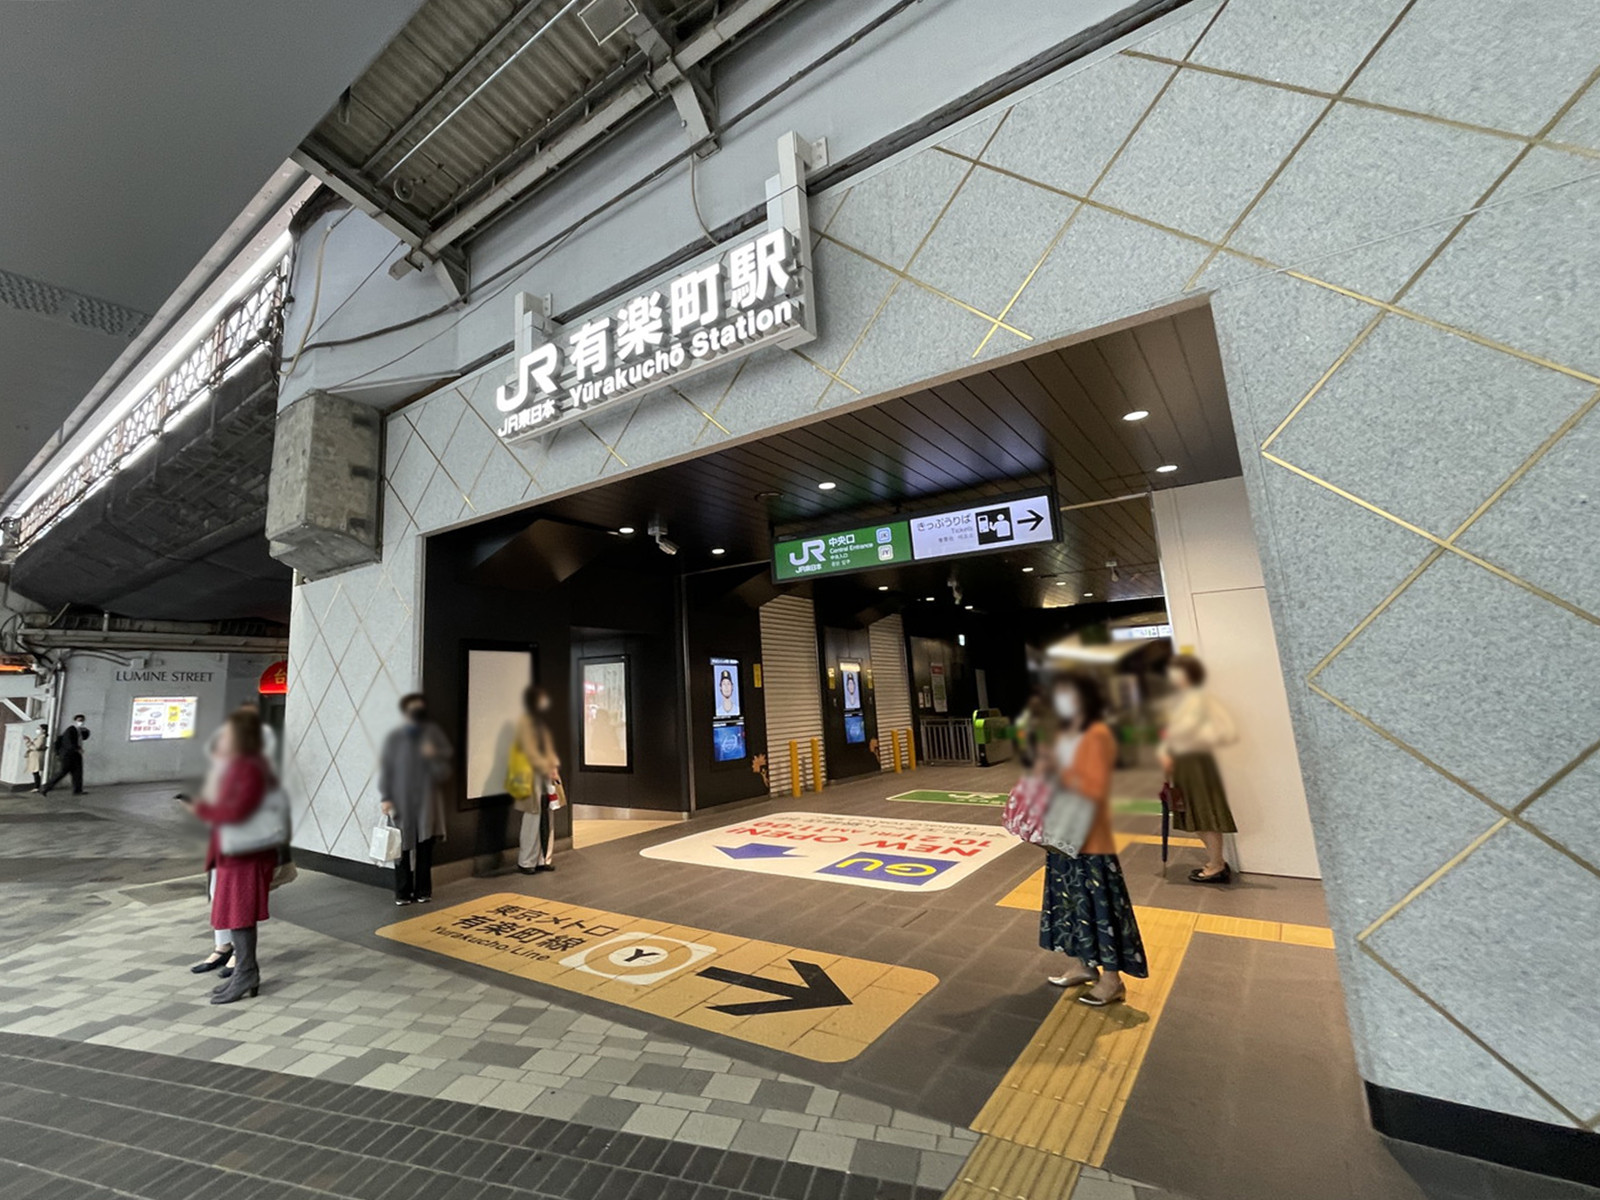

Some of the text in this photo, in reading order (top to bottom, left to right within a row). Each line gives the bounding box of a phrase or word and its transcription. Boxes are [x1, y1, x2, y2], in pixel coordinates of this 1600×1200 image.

[496, 228, 793, 412] JR 有楽町駅
[690, 300, 793, 358] Station
[917, 513, 971, 531] きっぷうりば
[828, 534, 855, 547] 中央口
[789, 539, 827, 565] JR
[116, 671, 215, 682] LUMINE STREET
[859, 840, 983, 857] NEW
[835, 857, 937, 877] GU
[485, 904, 620, 937] 東京メトロ
[451, 914, 587, 952] 有楽町線
[510, 947, 551, 961] Line
[623, 948, 661, 963] Y
